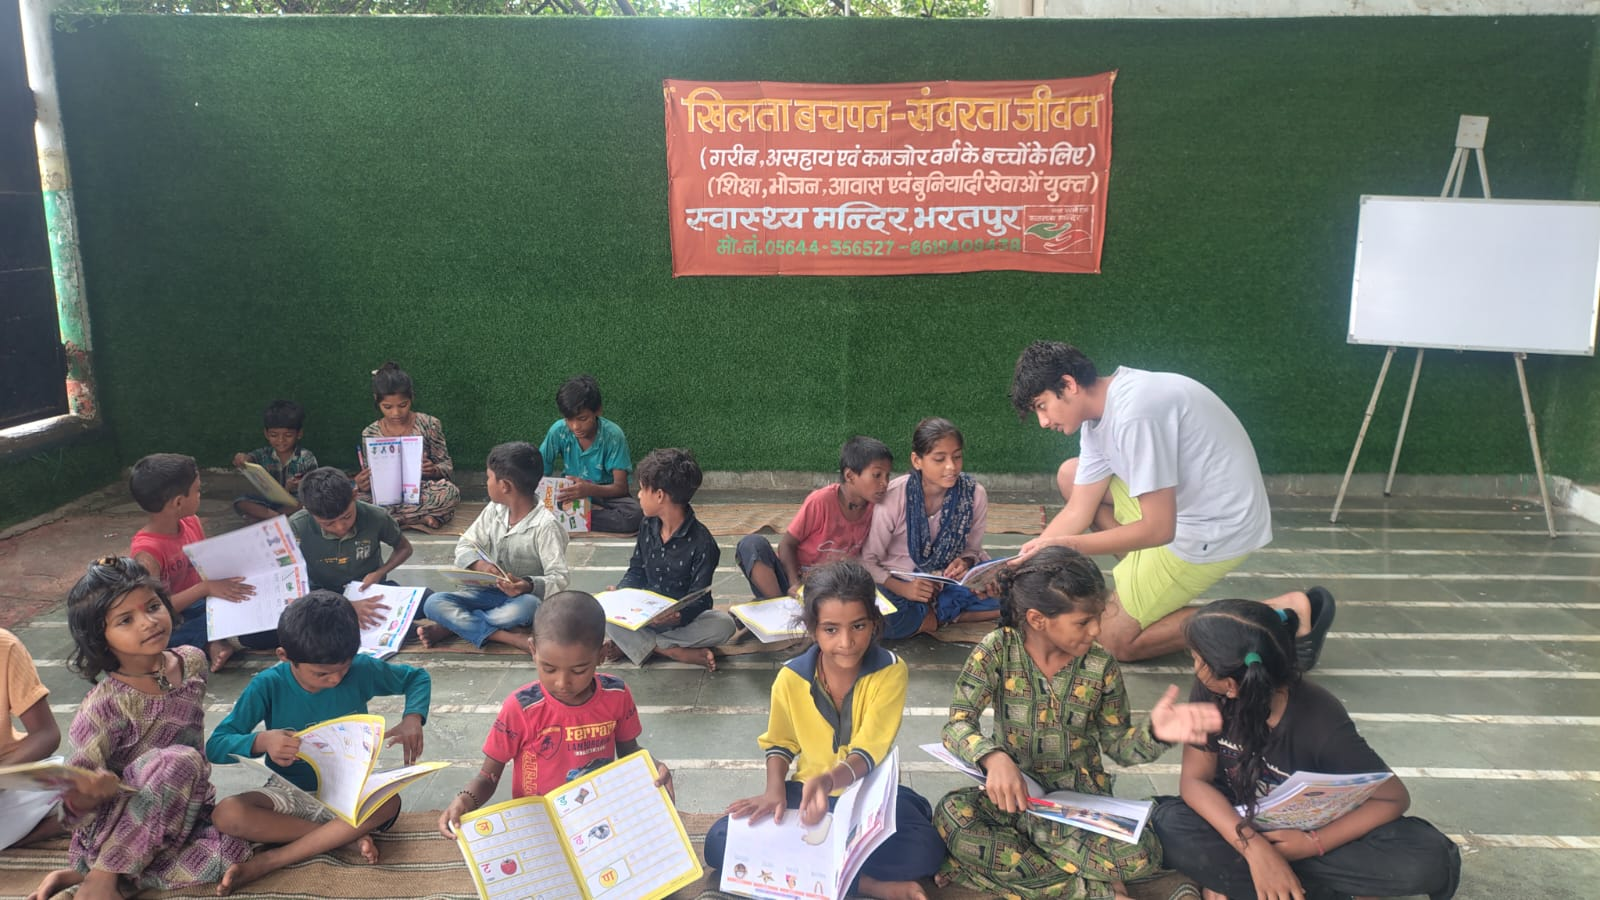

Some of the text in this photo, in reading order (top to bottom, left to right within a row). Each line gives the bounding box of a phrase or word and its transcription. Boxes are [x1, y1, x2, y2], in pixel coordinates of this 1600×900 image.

[681, 86, 793, 133] खिलता
[1012, 85, 1105, 132] जीवन
[836, 144, 862, 167] एवं
[861, 144, 931, 167] कमजोर
[930, 139, 961, 166] वर्ग
[960, 142, 980, 164] के
[981, 142, 1031, 166] बच्चों
[1028, 141, 1048, 164] के
[886, 170, 913, 195] एवं
[912, 169, 984, 202] बुनियादी
[984, 170, 1044, 194] सेवाओं
[685, 206, 810, 231] स्वास्थ्य
